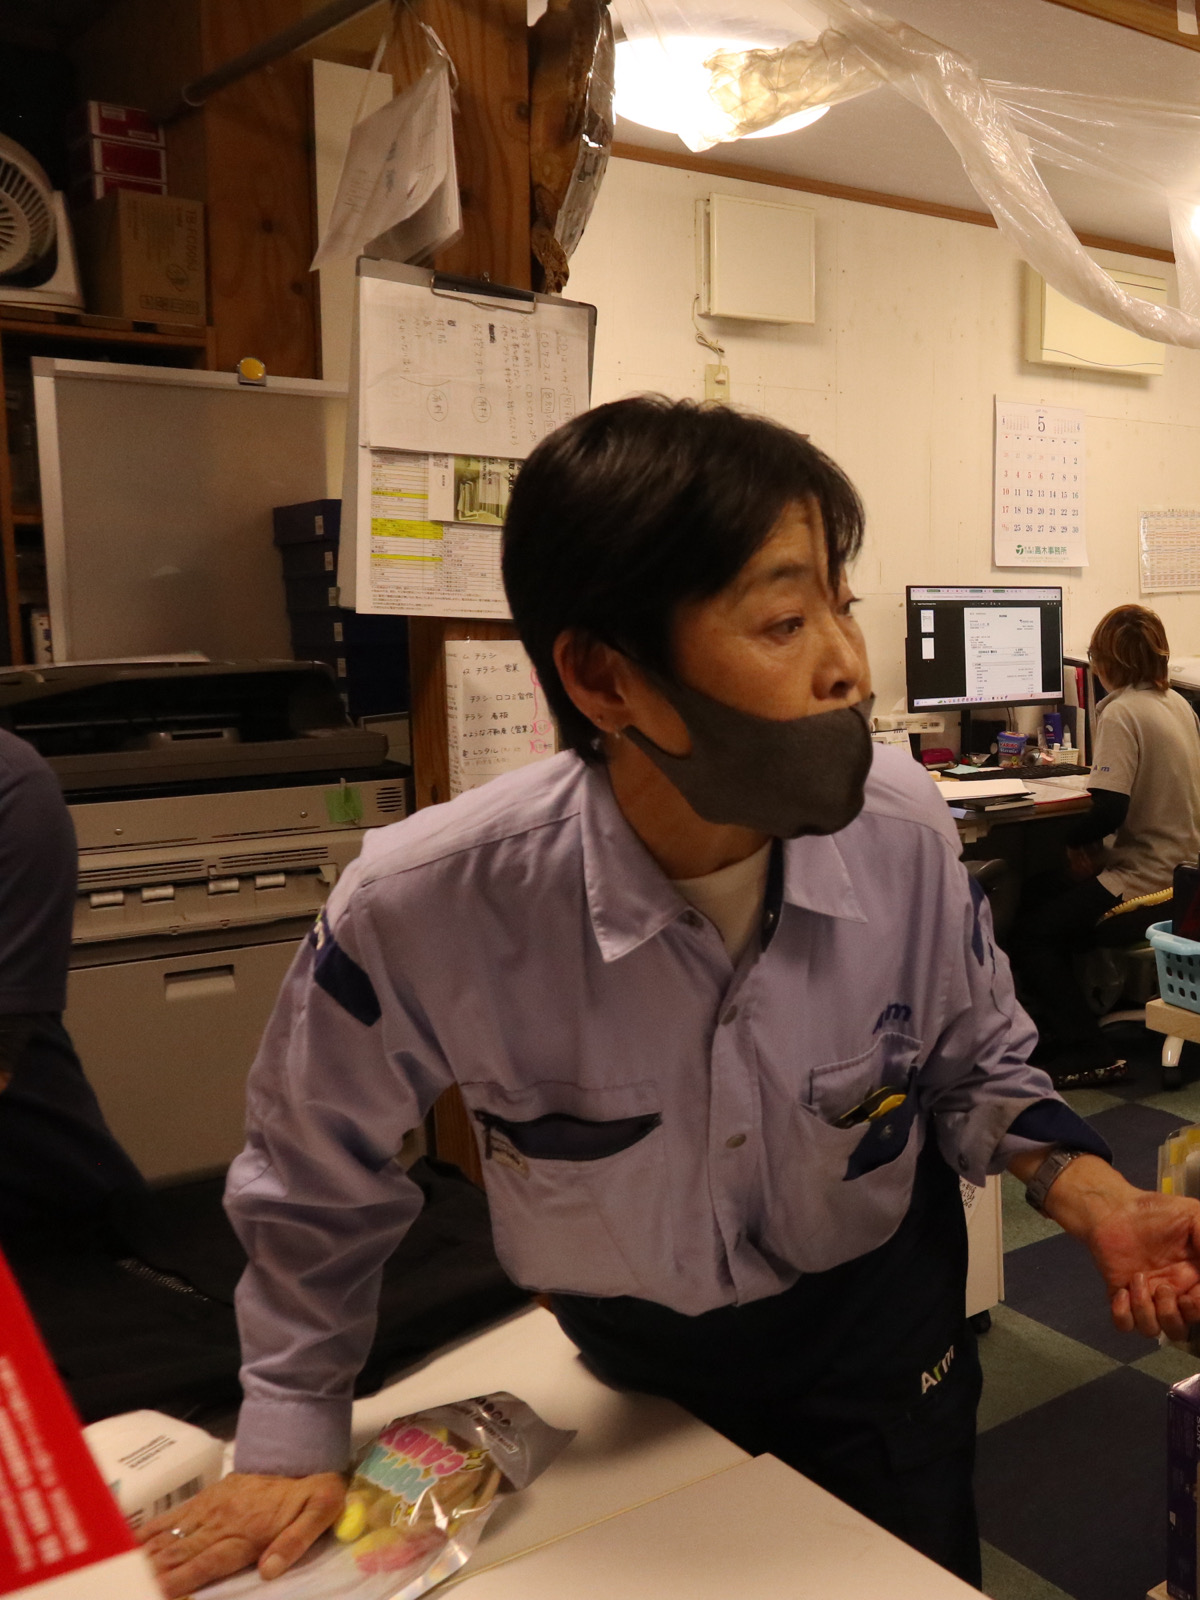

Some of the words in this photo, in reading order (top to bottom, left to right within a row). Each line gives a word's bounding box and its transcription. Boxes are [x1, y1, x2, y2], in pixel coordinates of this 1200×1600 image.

[1038, 416, 1046, 432] 5
[1026, 489, 1033, 497] 12
[1014, 506, 1021, 514] 18
[1037, 507, 1045, 515] 20
[1061, 508, 1068, 516] 22
[921, 1344, 955, 1395] Arm
